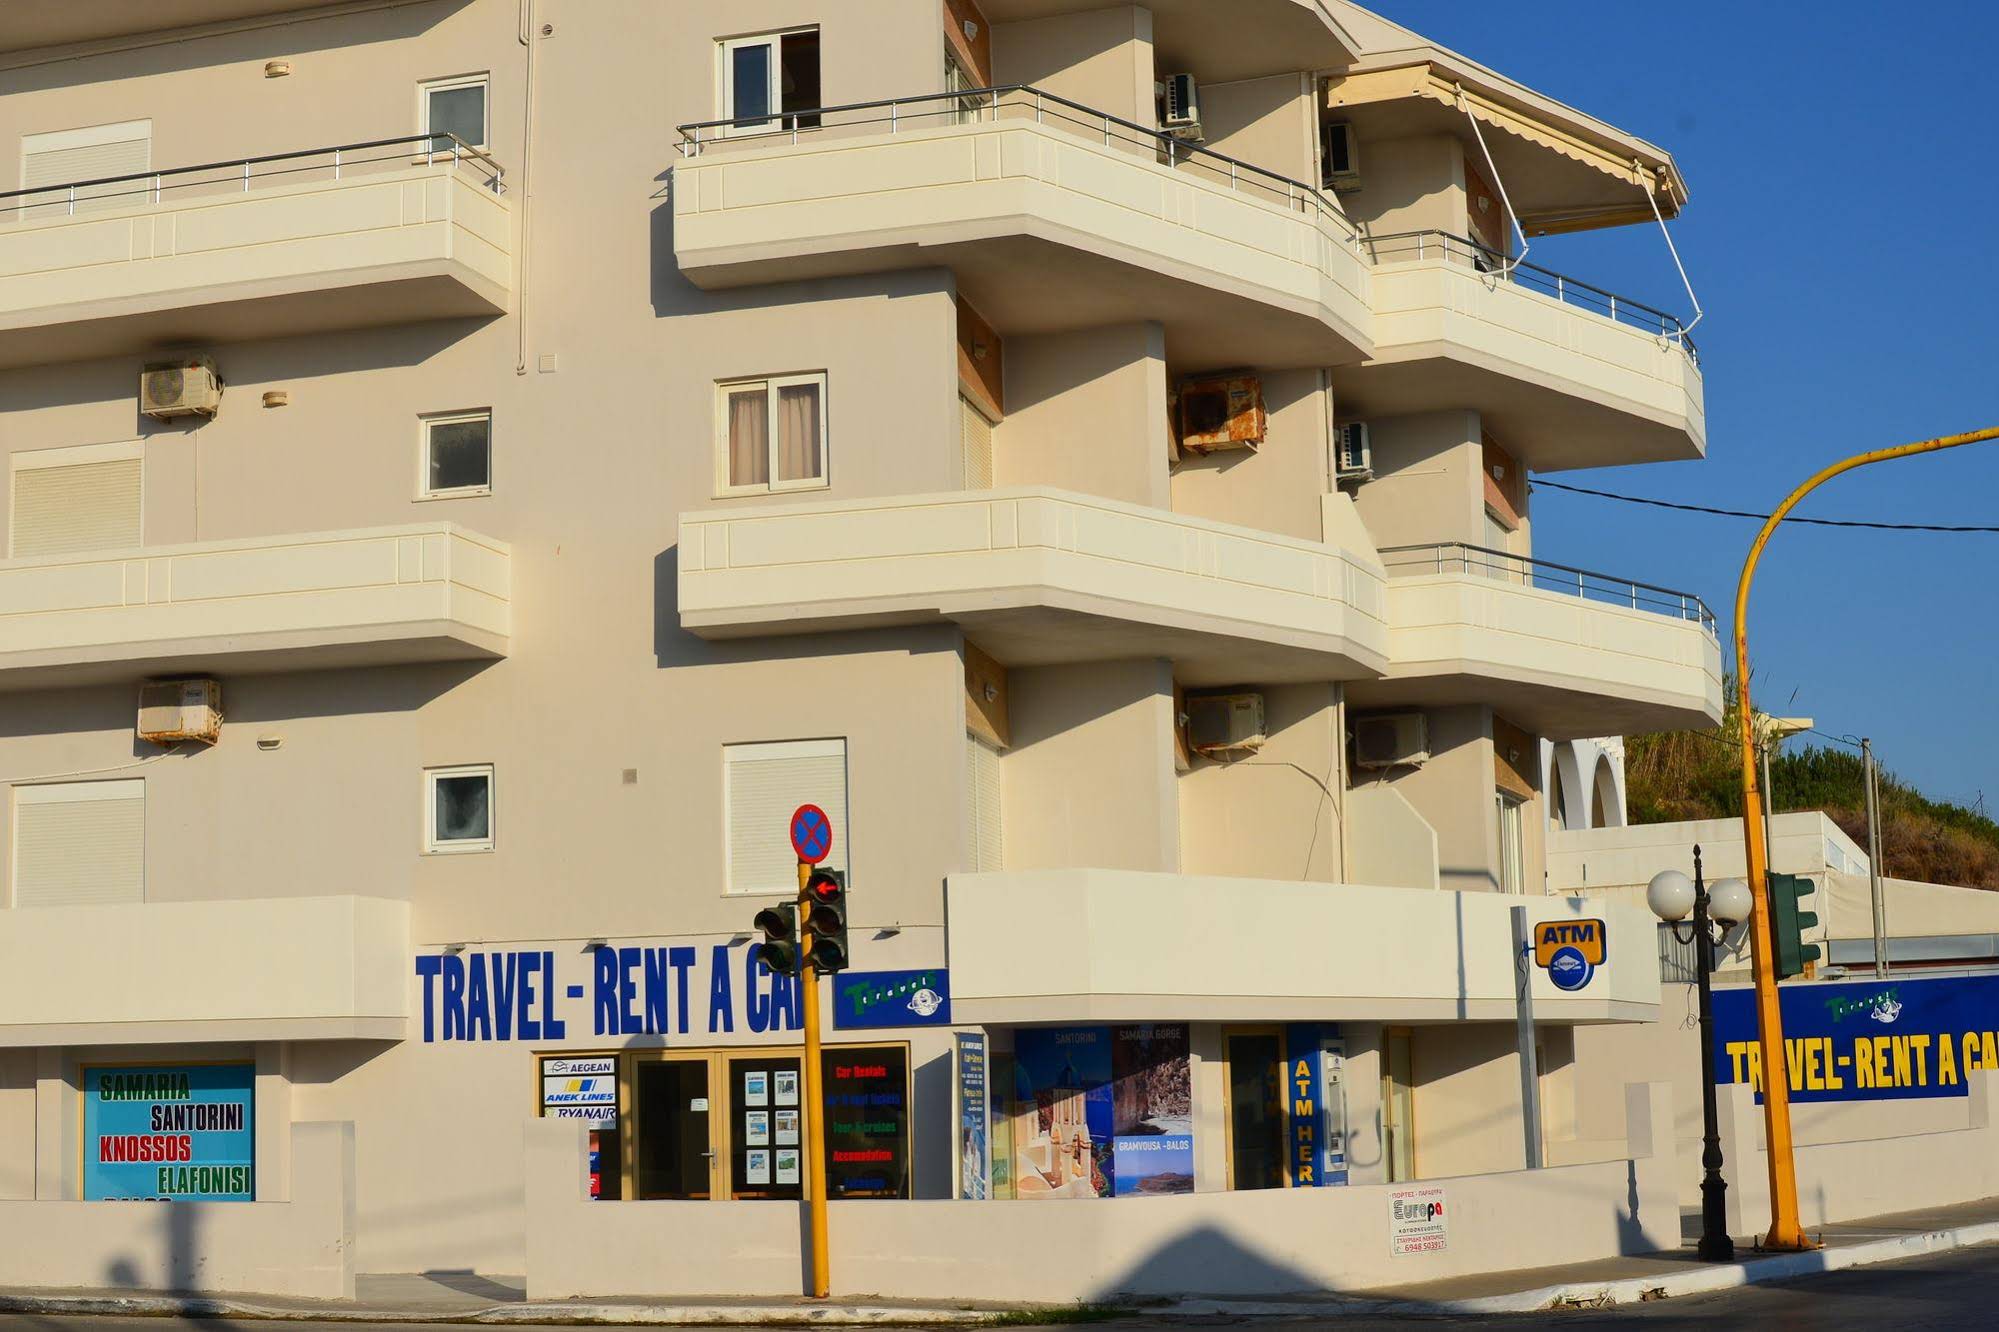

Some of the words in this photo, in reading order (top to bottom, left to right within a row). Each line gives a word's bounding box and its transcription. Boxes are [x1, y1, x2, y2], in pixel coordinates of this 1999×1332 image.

[1543, 925, 1594, 944] ATM
[416, 952, 565, 1043] TRAVEL
[594, 946, 696, 1036] RENT
[709, 945, 734, 1033] A
[1056, 1031, 1097, 1044] SANTORINI
[1119, 1029, 1153, 1040] SAMARIA
[1155, 1028, 1182, 1039] GORGE
[570, 1063, 611, 1073] AEGEAN
[1938, 1033, 1957, 1085] A
[1962, 1031, 1999, 1082] CA
[836, 1066, 852, 1078] Car
[100, 1073, 191, 1100] SAMARIA
[546, 1093, 580, 1102] ANEK
[581, 1093, 614, 1101] LINES
[1295, 1060, 1313, 1117] ATM
[151, 1103, 244, 1131] SANTORINI
[558, 1107, 616, 1120] RYANAIR
[100, 1135, 191, 1162] KNOSSOS
[1119, 1141, 1161, 1151] GRAMVOUSA
[1297, 1125, 1314, 1187] HER
[158, 1166, 250, 1194] ELAFONISI
